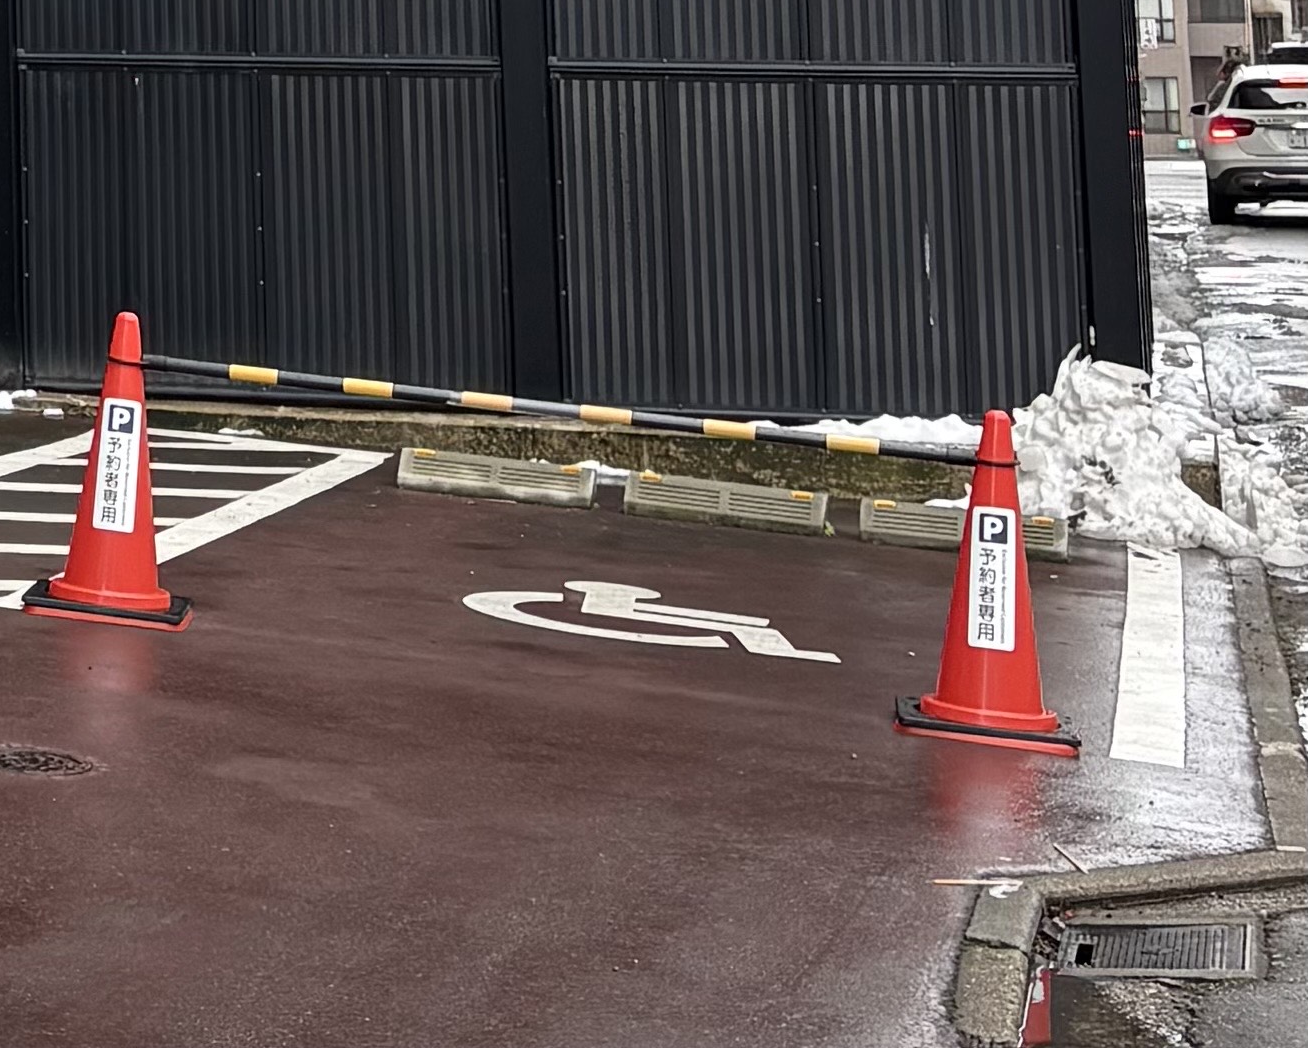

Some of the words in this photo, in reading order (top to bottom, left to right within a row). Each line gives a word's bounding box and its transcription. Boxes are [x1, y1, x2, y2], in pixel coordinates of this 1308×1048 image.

[112, 408, 131, 431] P
[101, 437, 122, 523] 予約者専用
[982, 518, 1004, 541] P
[977, 548, 996, 642] 予約者専用
